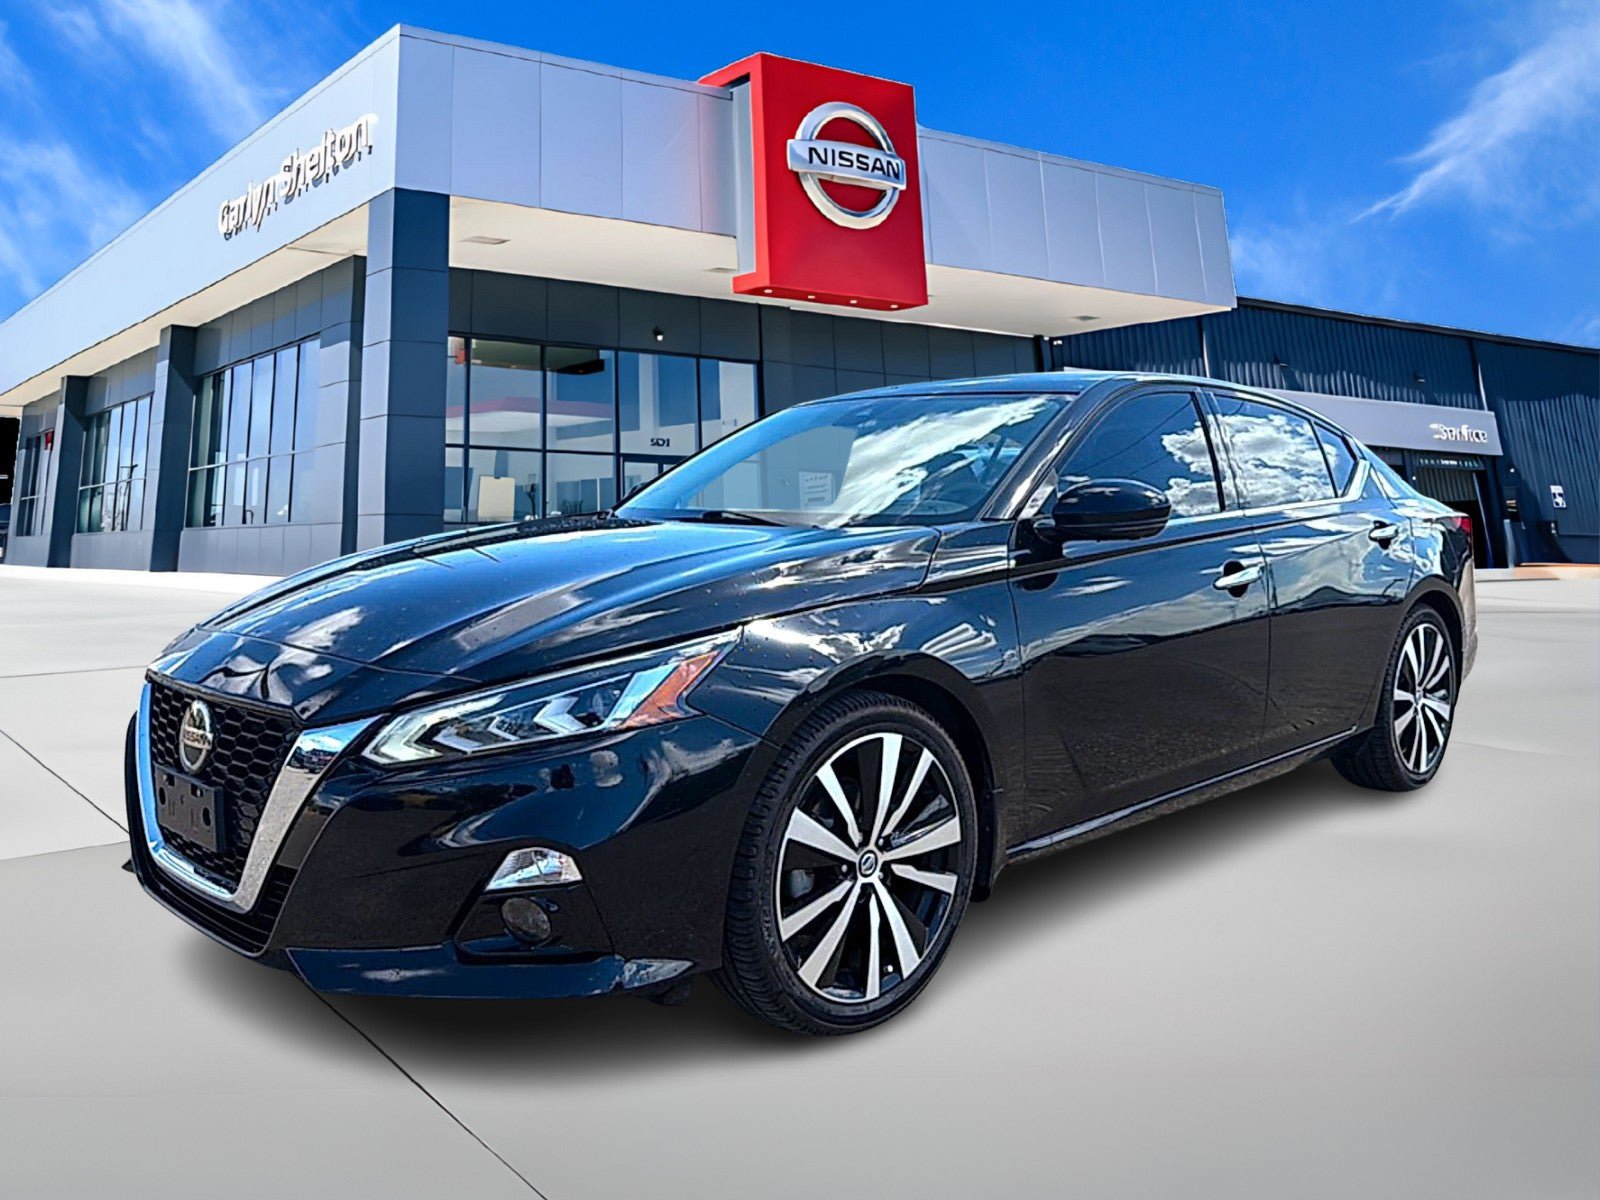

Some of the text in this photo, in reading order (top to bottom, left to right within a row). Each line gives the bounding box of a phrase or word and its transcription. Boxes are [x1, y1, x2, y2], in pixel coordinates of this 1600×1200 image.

[279, 114, 377, 205] Shelton
[808, 147, 900, 180] NISSAN
[1430, 423, 1488, 443] Service
